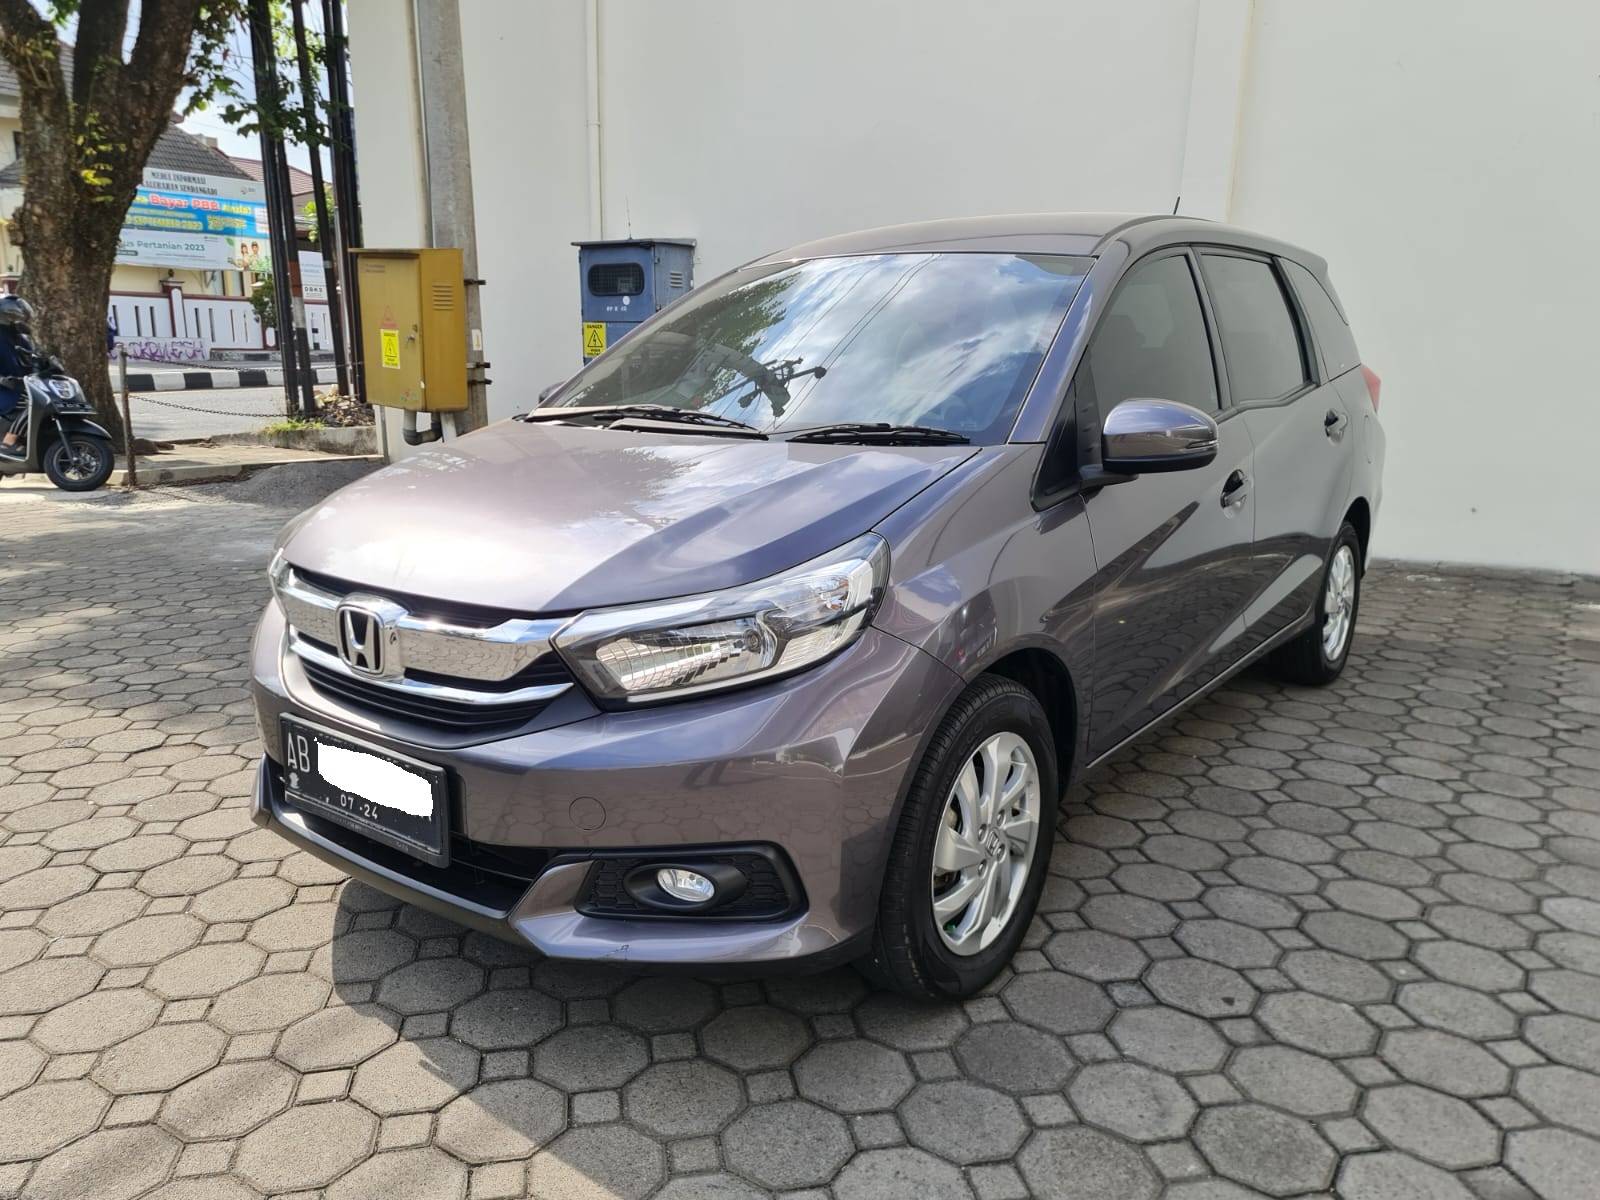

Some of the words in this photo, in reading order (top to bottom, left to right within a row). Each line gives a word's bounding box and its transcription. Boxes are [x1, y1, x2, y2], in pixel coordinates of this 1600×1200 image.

[150, 194, 188, 209] Bayar
[136, 240, 183, 250] Pertanian
[184, 243, 206, 251] 2023
[287, 732, 310, 773] AB
[340, 794, 354, 810] 07
